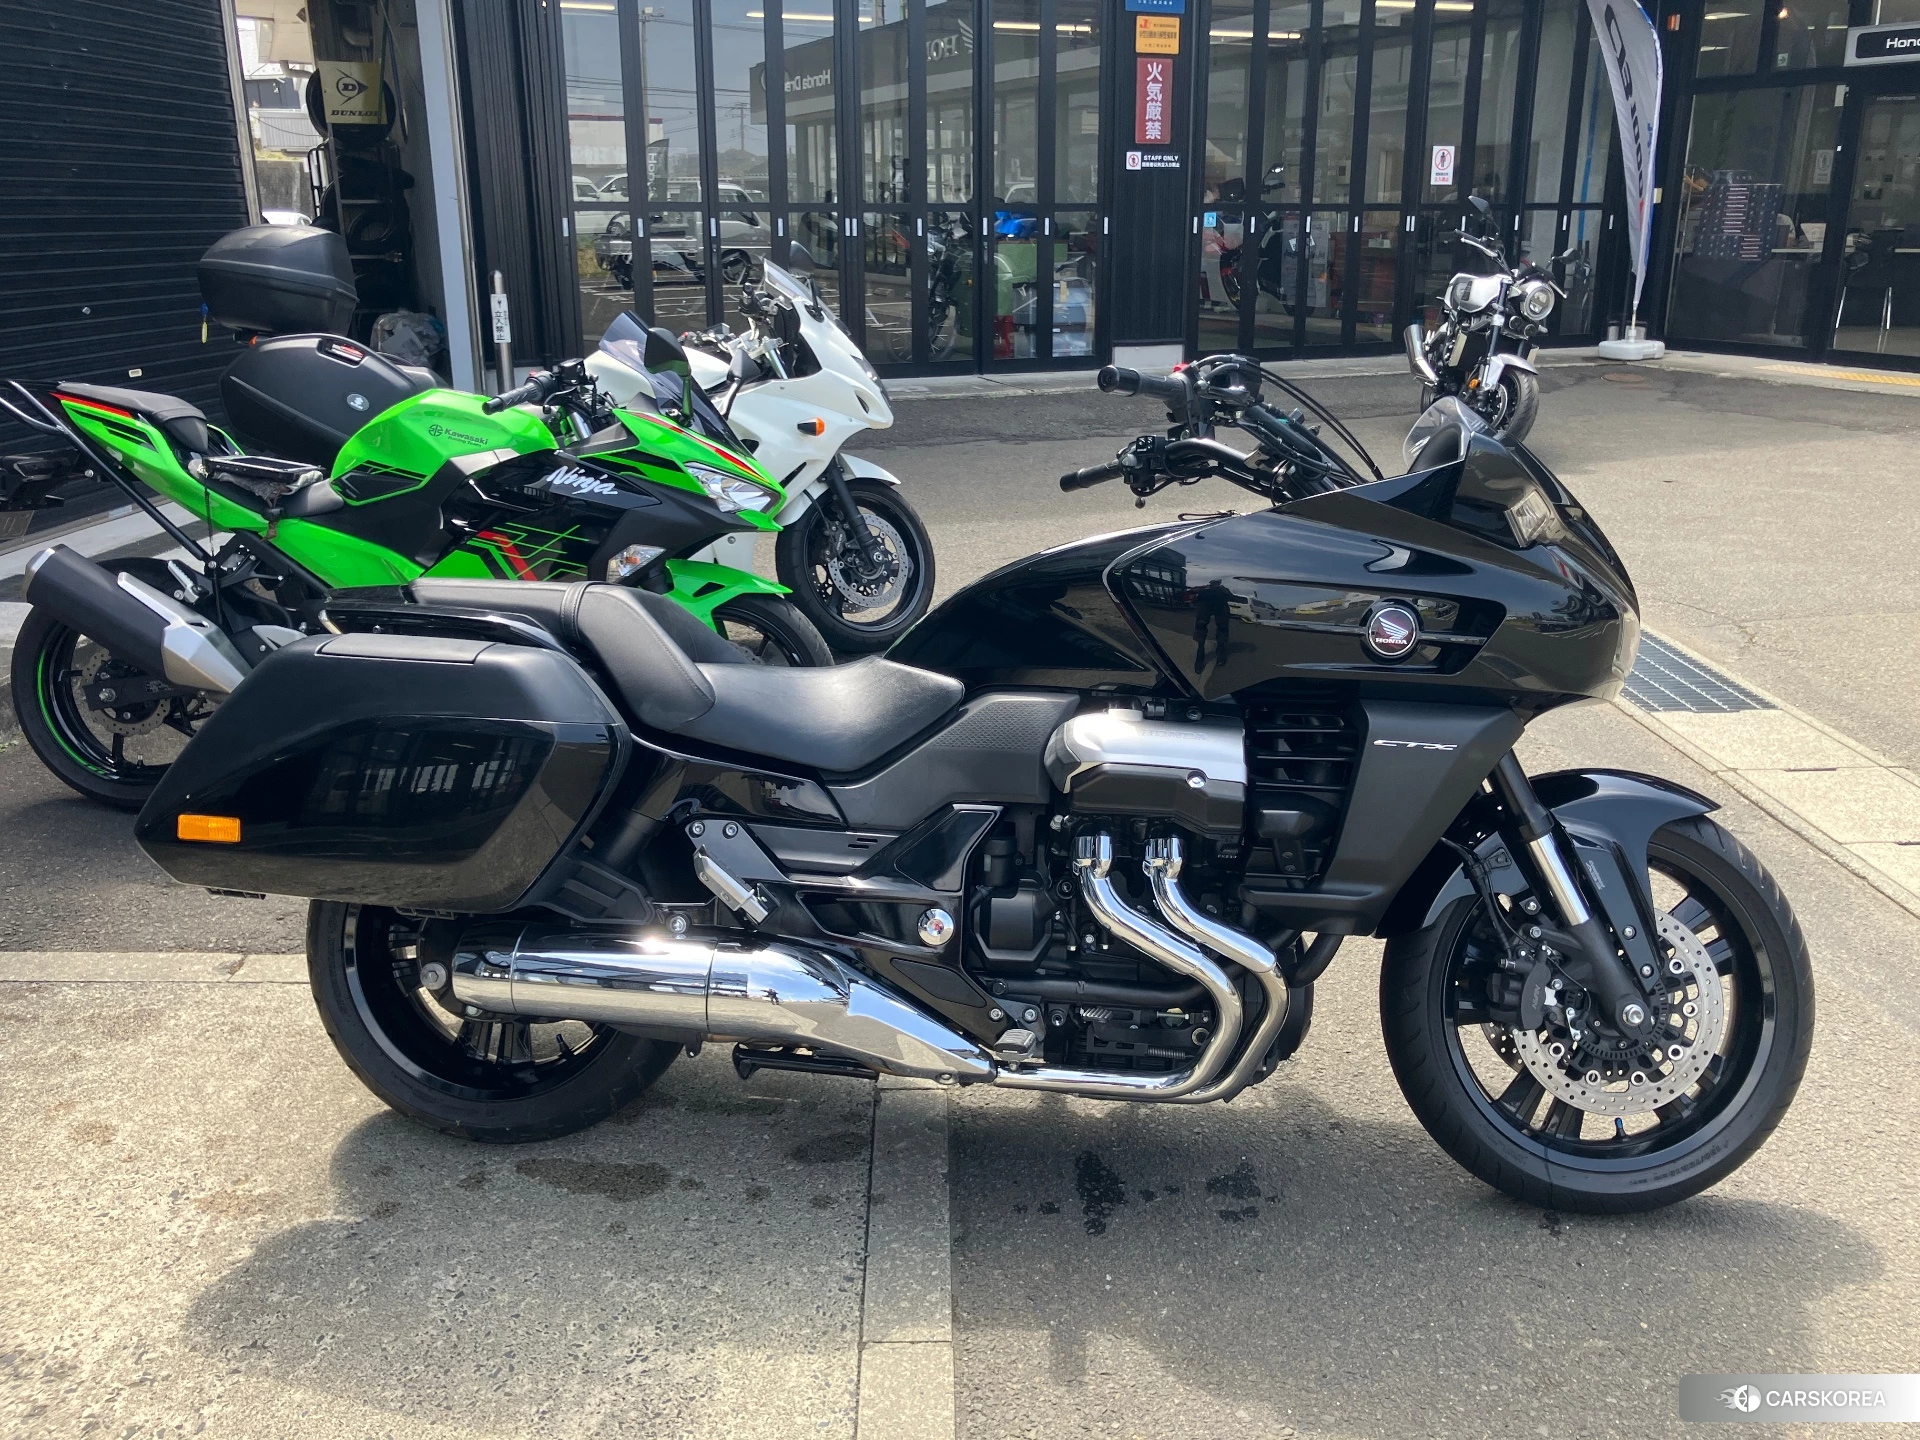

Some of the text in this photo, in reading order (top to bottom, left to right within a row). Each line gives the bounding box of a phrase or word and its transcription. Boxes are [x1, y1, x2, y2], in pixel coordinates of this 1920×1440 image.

[1145, 61, 1163, 140] 火気厳禁
[494, 310, 505, 341] 立入禁止
[444, 428, 488, 445] Kawasaki
[546, 466, 618, 495] Ninja
[1375, 637, 1407, 645] HONDA
